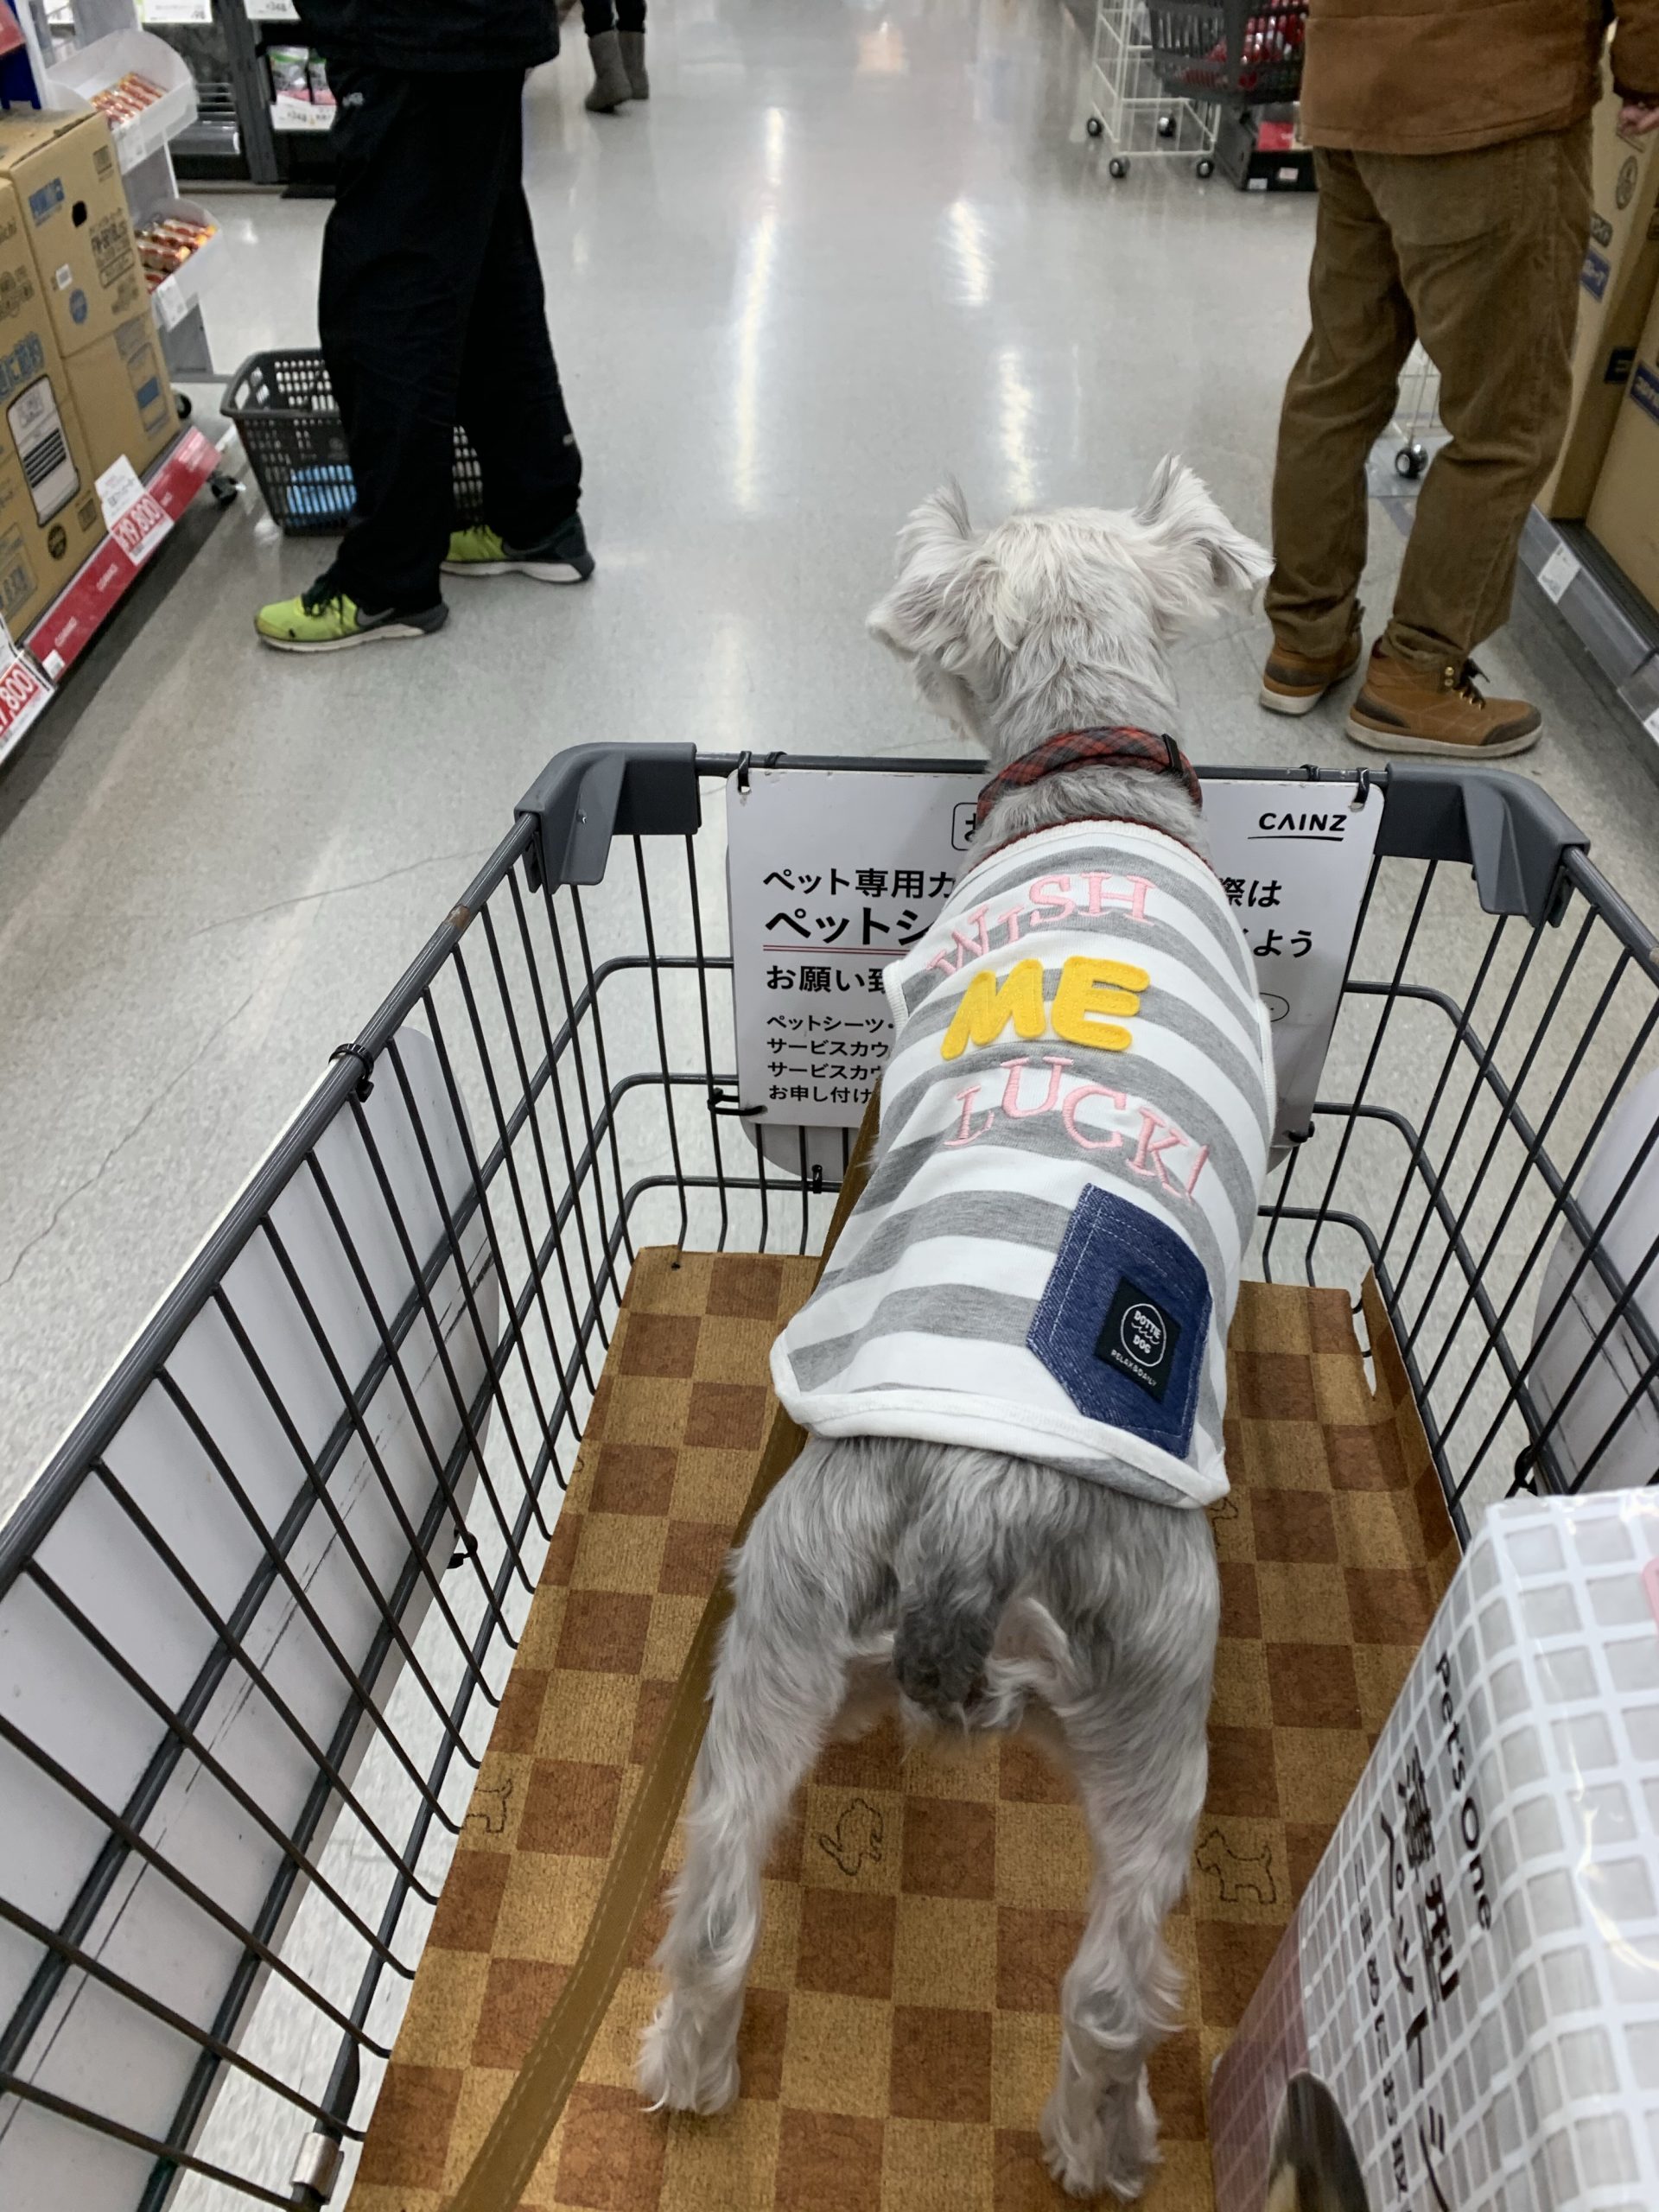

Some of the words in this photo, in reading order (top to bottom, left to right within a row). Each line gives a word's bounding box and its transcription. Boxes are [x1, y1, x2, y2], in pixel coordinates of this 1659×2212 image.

[1259, 813, 1348, 832] CAINZ
[926, 871, 1156, 975] WISH
[940, 956, 1151, 1060] ME
[767, 1038, 889, 1058] サービスカウ
[769, 1084, 872, 1104] お申し付け
[1133, 1310, 1162, 1339] DOTTIE
[1132, 1335, 1152, 1354] DOG
[1435, 1649, 1466, 1791] Pet's
[1461, 1797, 1491, 1931] One
